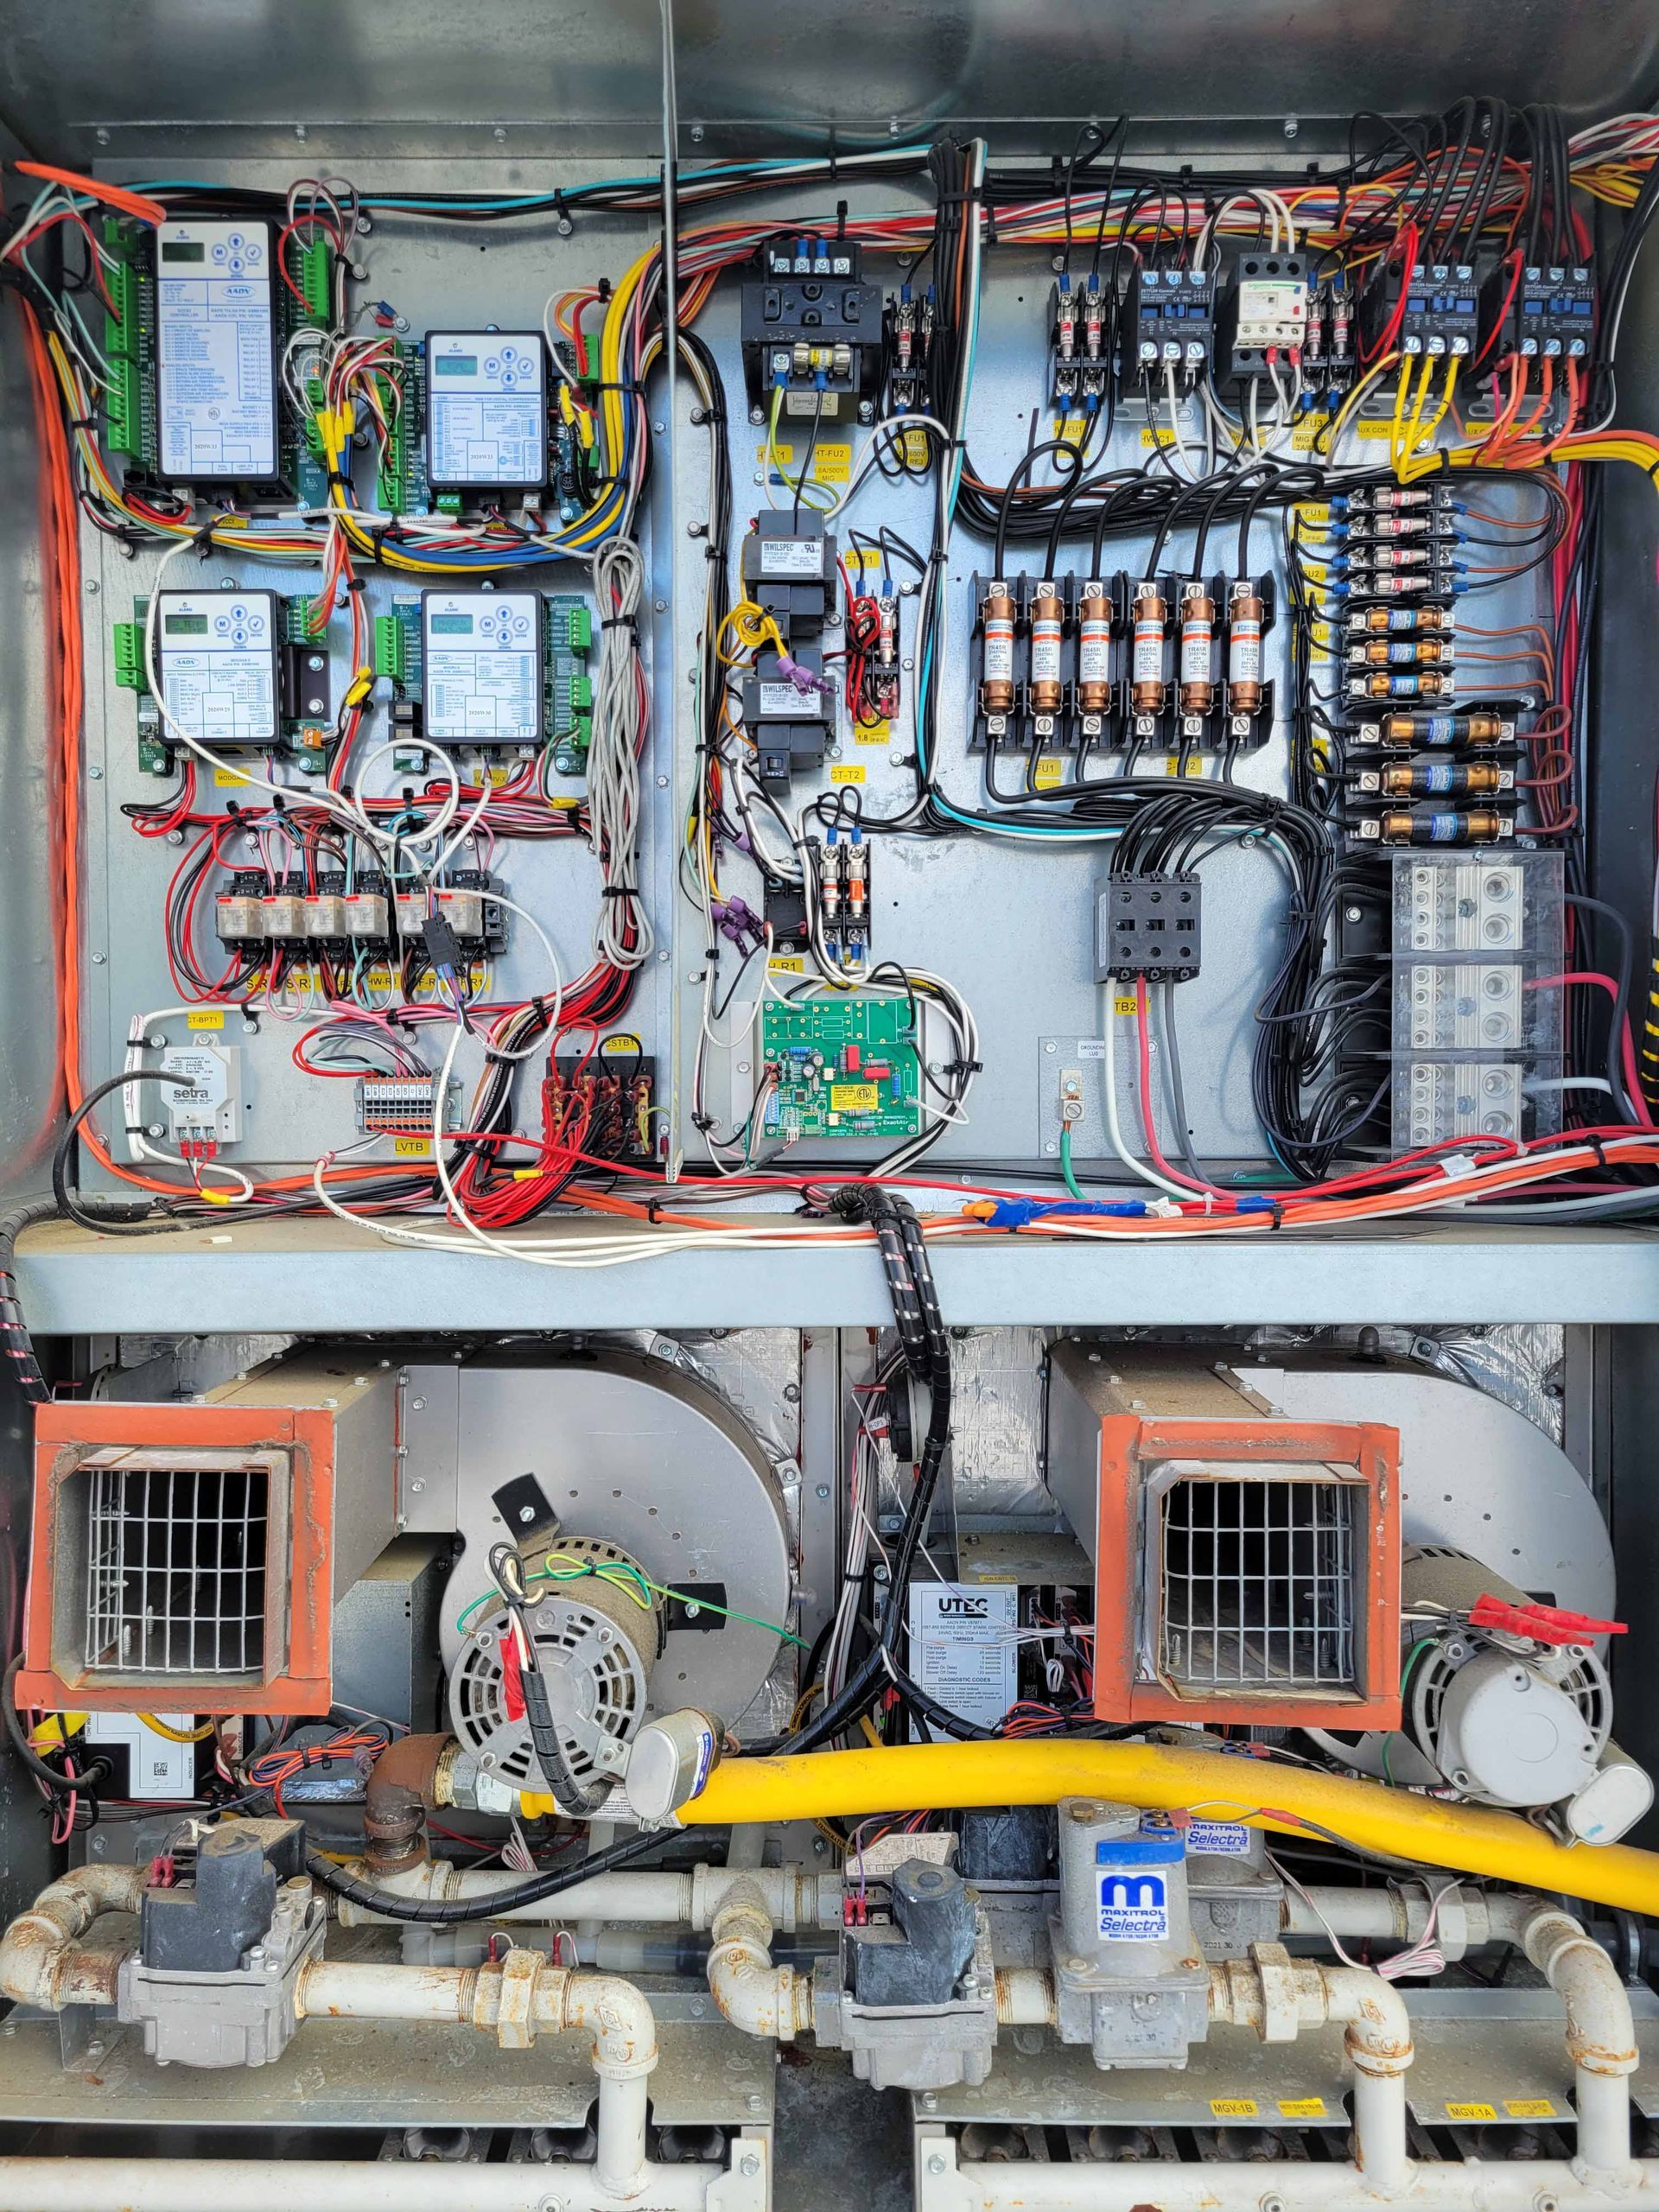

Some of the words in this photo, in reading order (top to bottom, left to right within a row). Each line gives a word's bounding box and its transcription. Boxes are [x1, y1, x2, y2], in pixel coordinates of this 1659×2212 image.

[173, 1088, 209, 1098] setra
[395, 1142, 424, 1152] LVTB
[938, 1599, 988, 1612] UTEC
[1188, 1831, 1248, 1845] Selectra
[1100, 1917, 1166, 1932] Selectra
[1213, 2104, 1253, 2113] MGV-1B
[1452, 2108, 1492, 2117] MGV-1A
